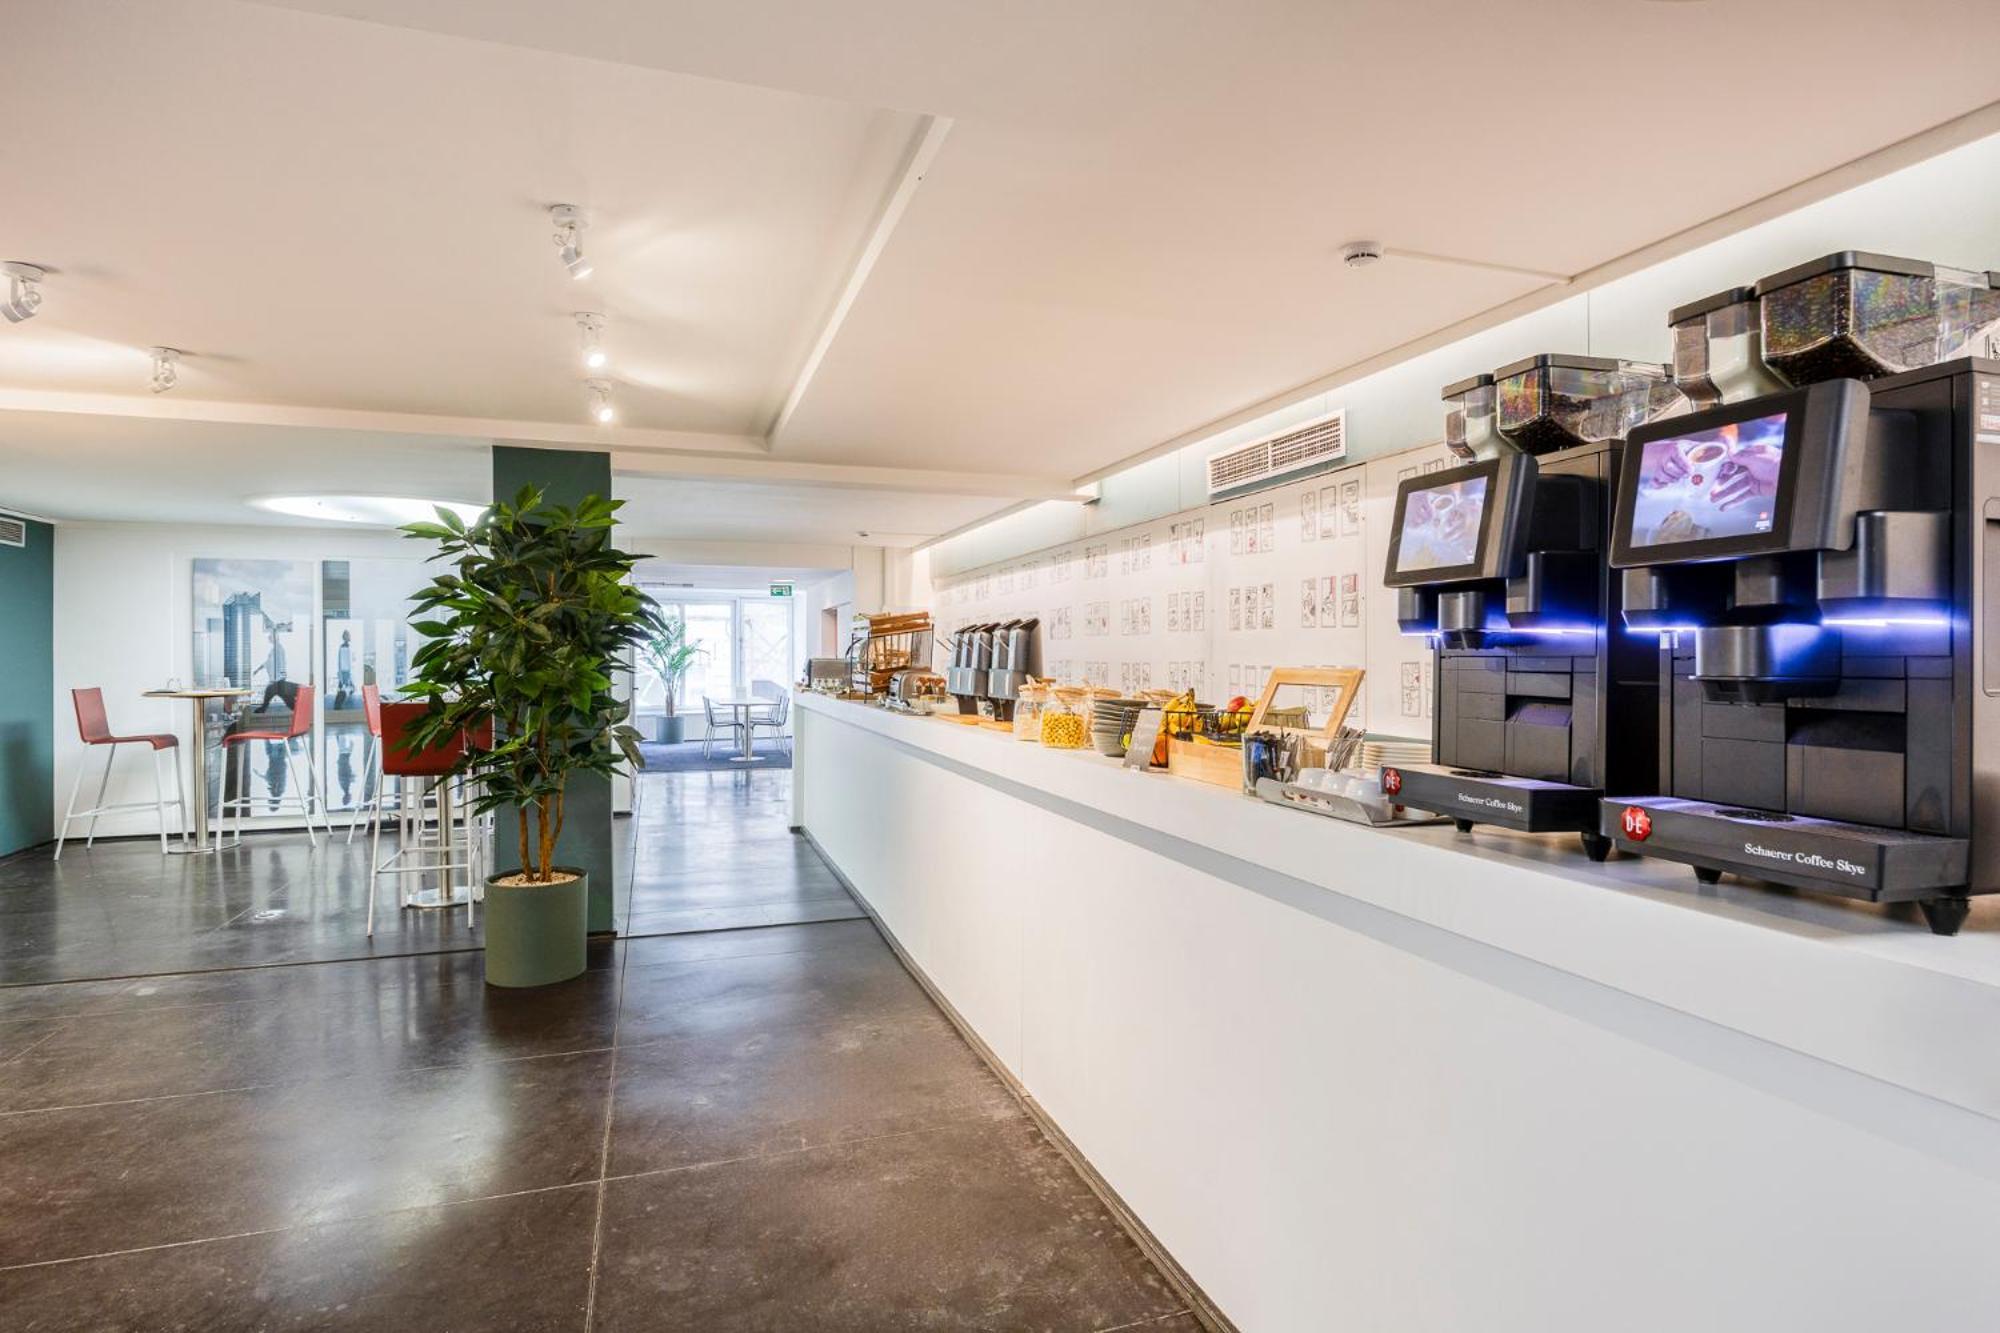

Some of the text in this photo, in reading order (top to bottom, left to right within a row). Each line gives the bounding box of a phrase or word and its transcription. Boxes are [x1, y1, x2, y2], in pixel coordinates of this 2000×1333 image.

[1485, 798, 1507, 810] Coffee
[1507, 801, 1523, 814] Skye
[1744, 843, 1866, 875] Schaerer Coffee Skye
